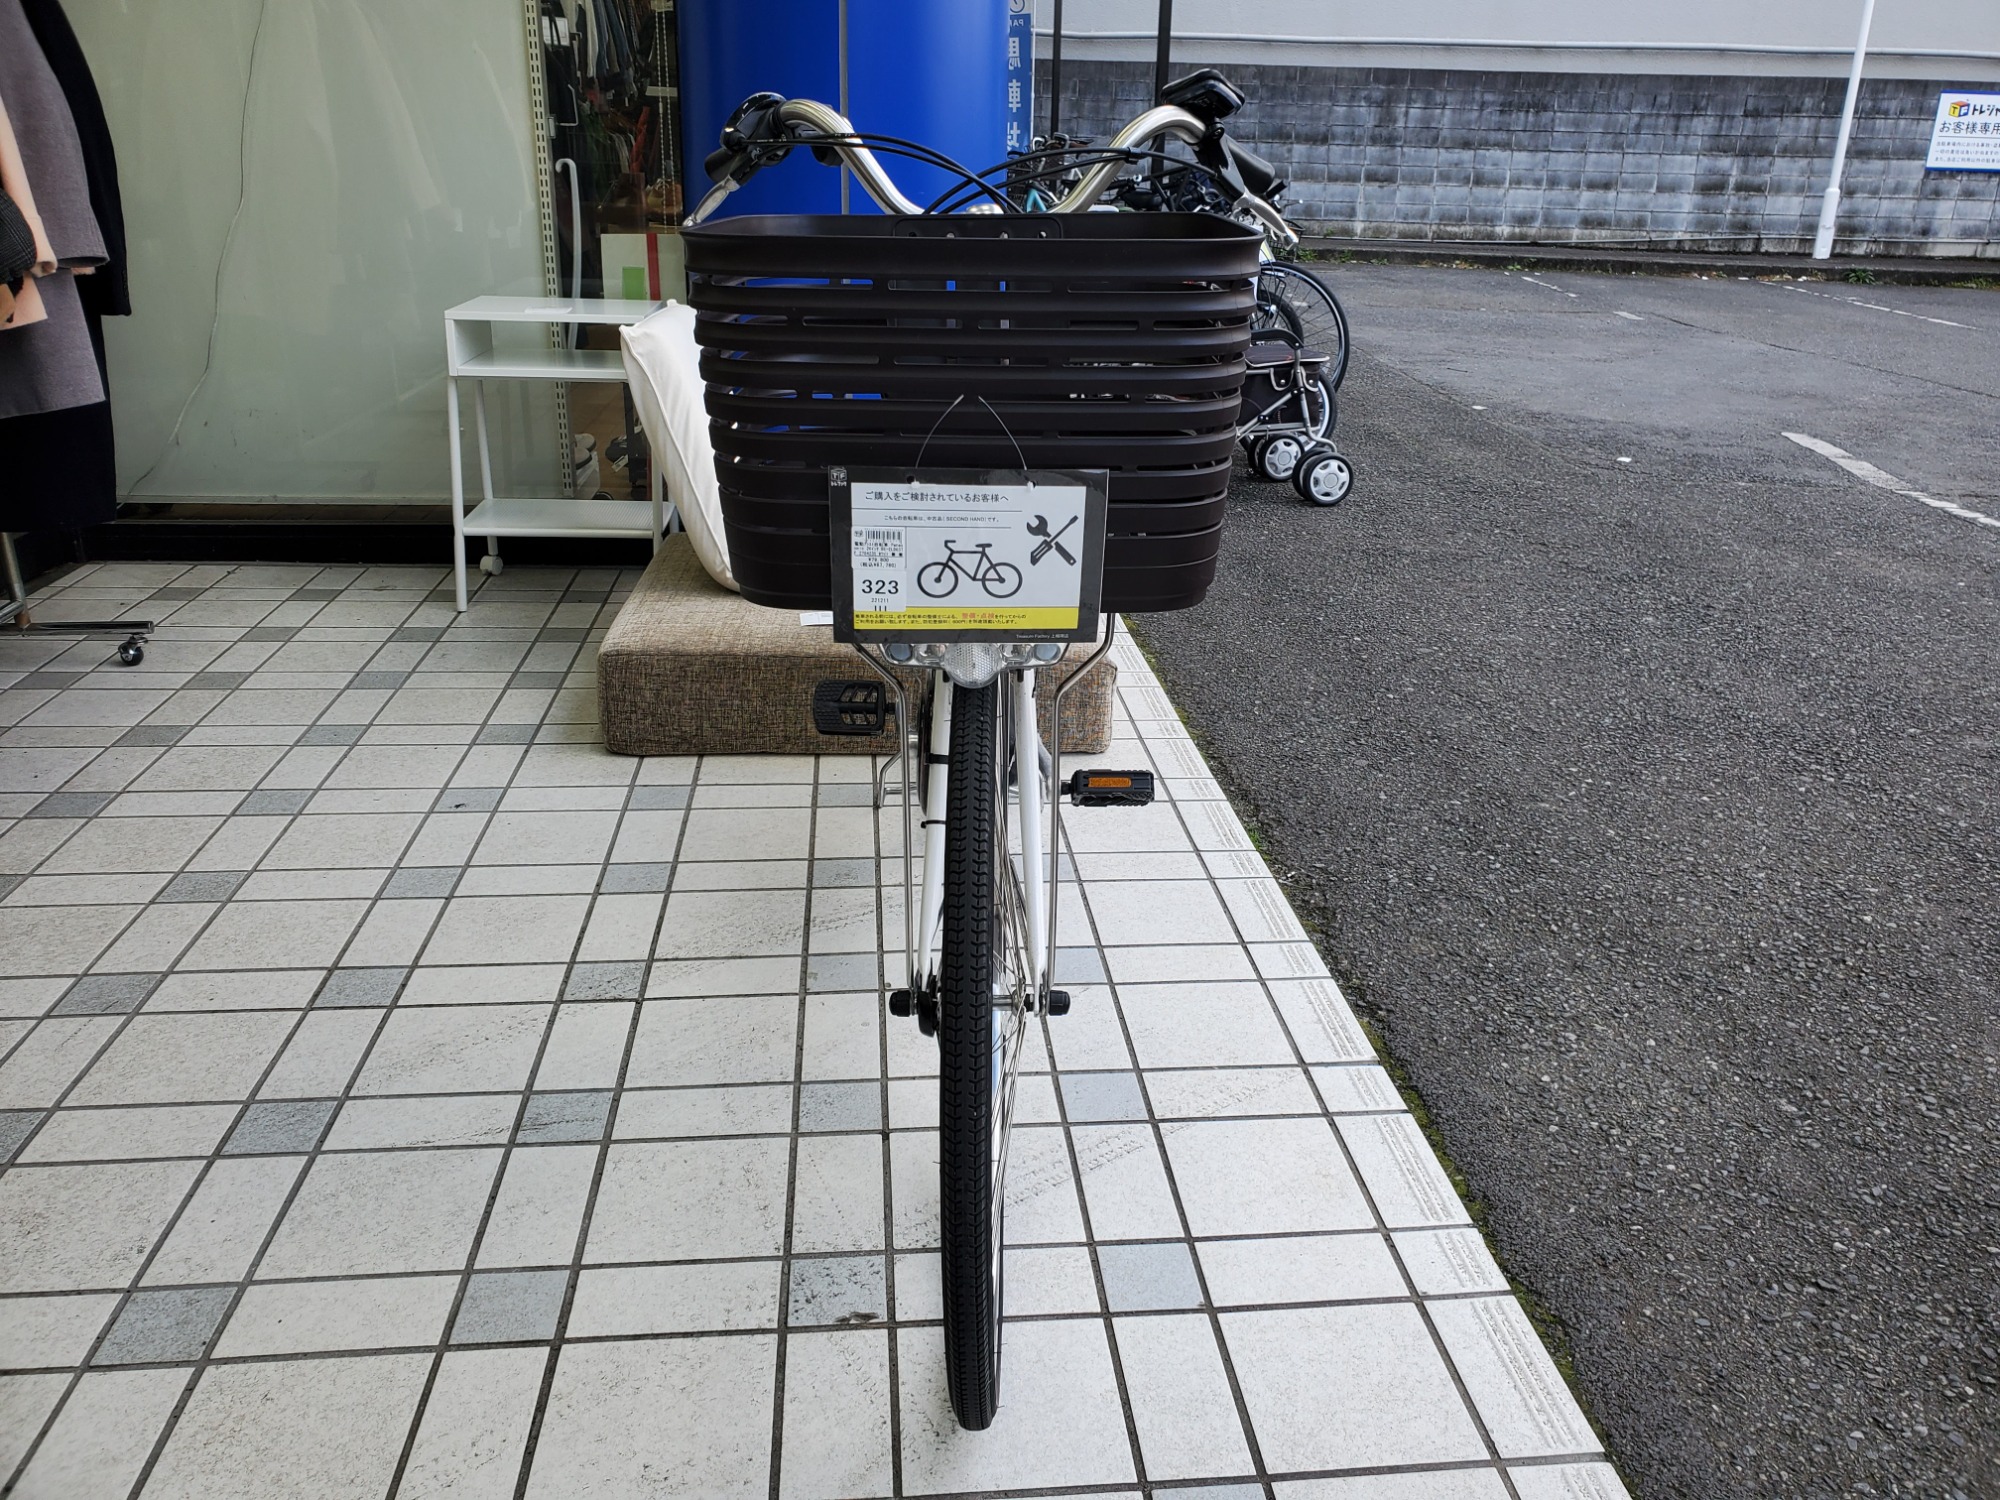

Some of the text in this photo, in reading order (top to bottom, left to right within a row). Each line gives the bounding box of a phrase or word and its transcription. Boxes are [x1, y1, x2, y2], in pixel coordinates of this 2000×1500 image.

[1939, 120, 2000, 135] お客様専用
[865, 491, 1009, 503] ご購入をご検討されているお客様へ
[861, 579, 899, 595] 323
